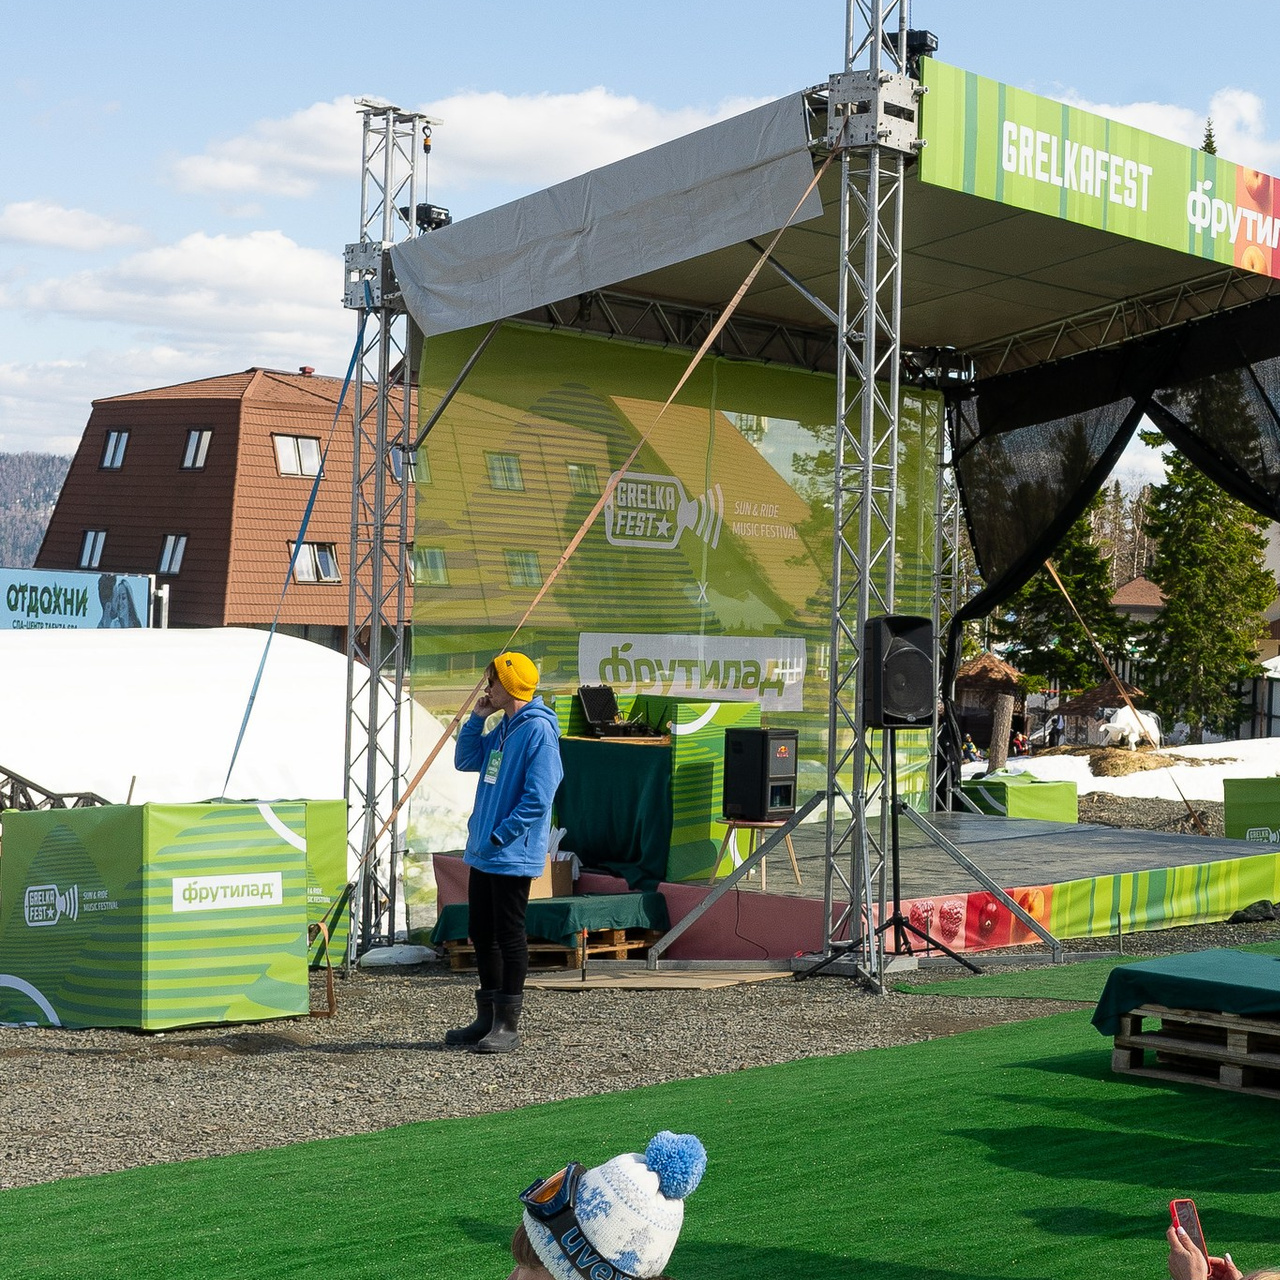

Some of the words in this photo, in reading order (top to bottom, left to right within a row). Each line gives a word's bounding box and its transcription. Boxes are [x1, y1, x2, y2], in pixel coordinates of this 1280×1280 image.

[1002, 120, 1153, 212] GRELKAFEST
[617, 481, 676, 511] GRELKA
[734, 501, 751, 516] SUN
[752, 503, 758, 516] &
[760, 503, 779, 518] RIDE
[616, 510, 657, 537] FEST
[733, 522, 760, 537] MUSIC
[761, 523, 799, 540] FESTIVAL
[6, 581, 89, 618] ОТДОХНИ
[599, 642, 786, 697] фрутилад
[29, 890, 55, 905] GRELKA
[182, 881, 272, 903] фрутилад
[29, 906, 47, 920] FEST
